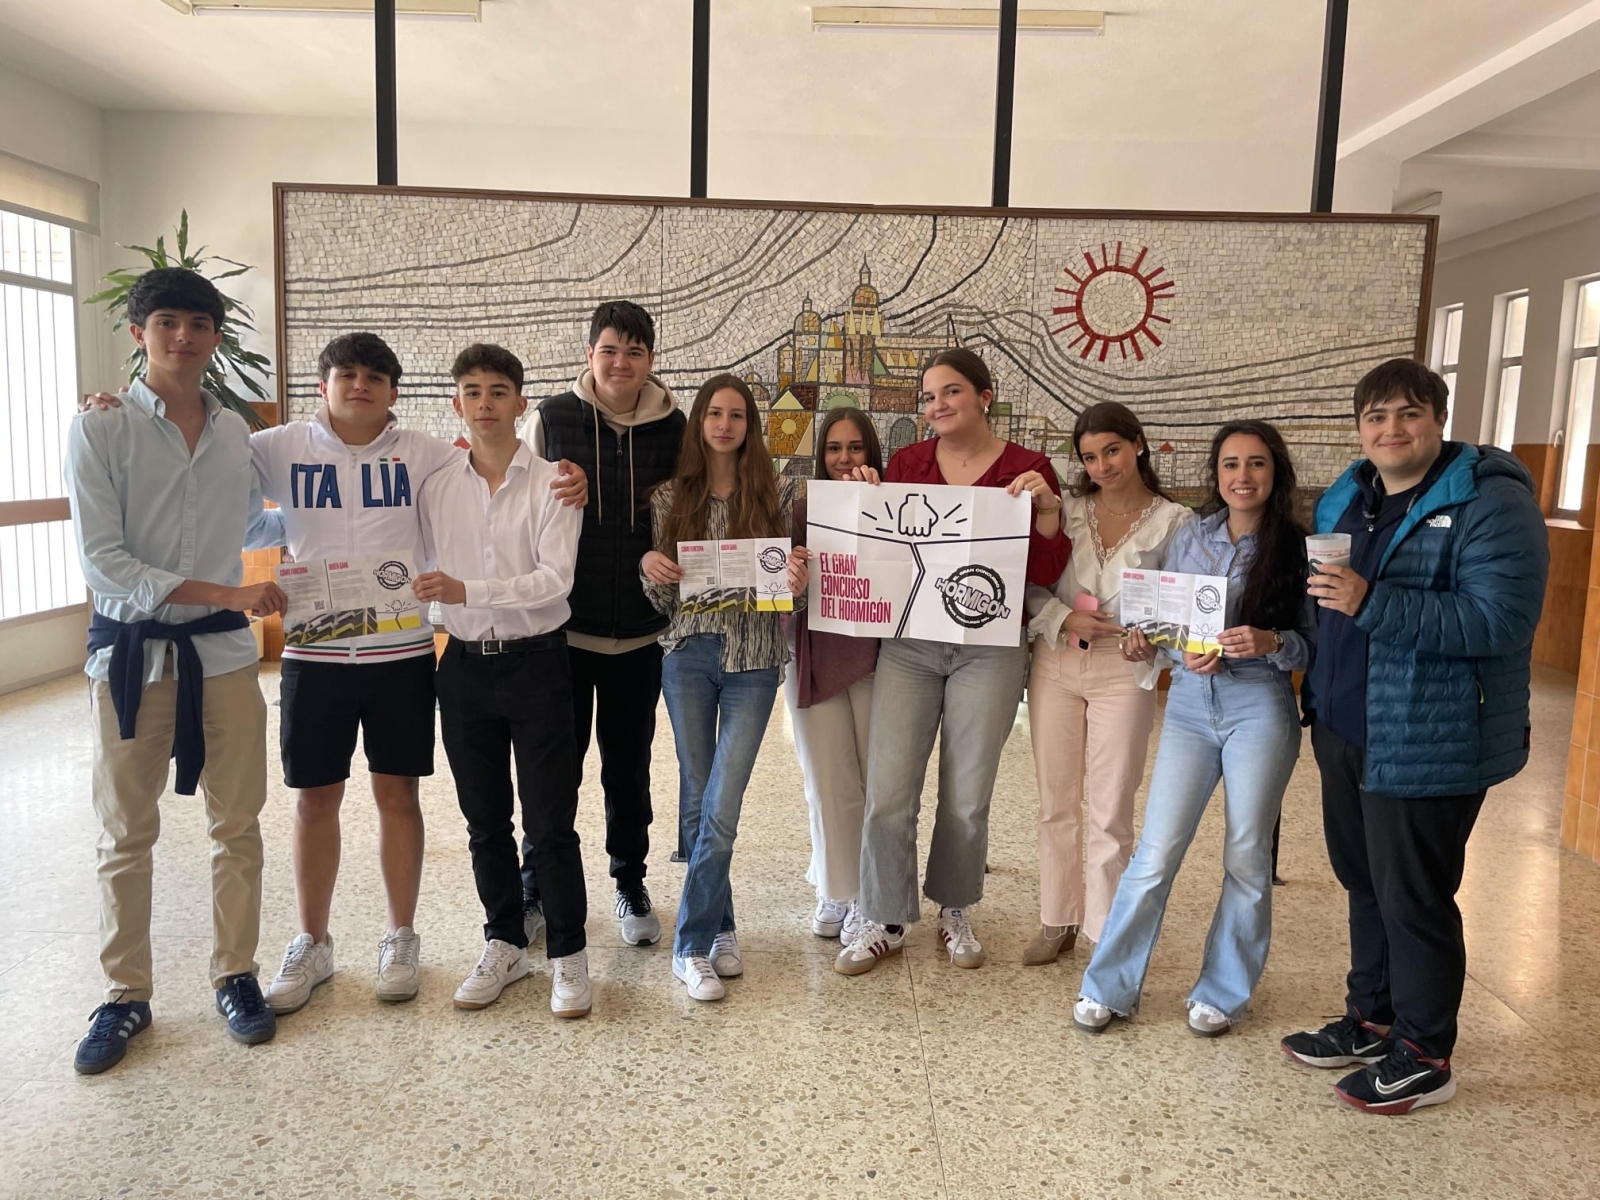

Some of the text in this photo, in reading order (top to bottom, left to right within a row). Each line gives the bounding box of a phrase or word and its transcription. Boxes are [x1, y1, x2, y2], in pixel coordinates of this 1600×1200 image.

[820, 552, 857, 576] EL GRAN
[820, 575, 870, 600] CONCURSO
[820, 597, 892, 624] DEL HORMIGÓN
